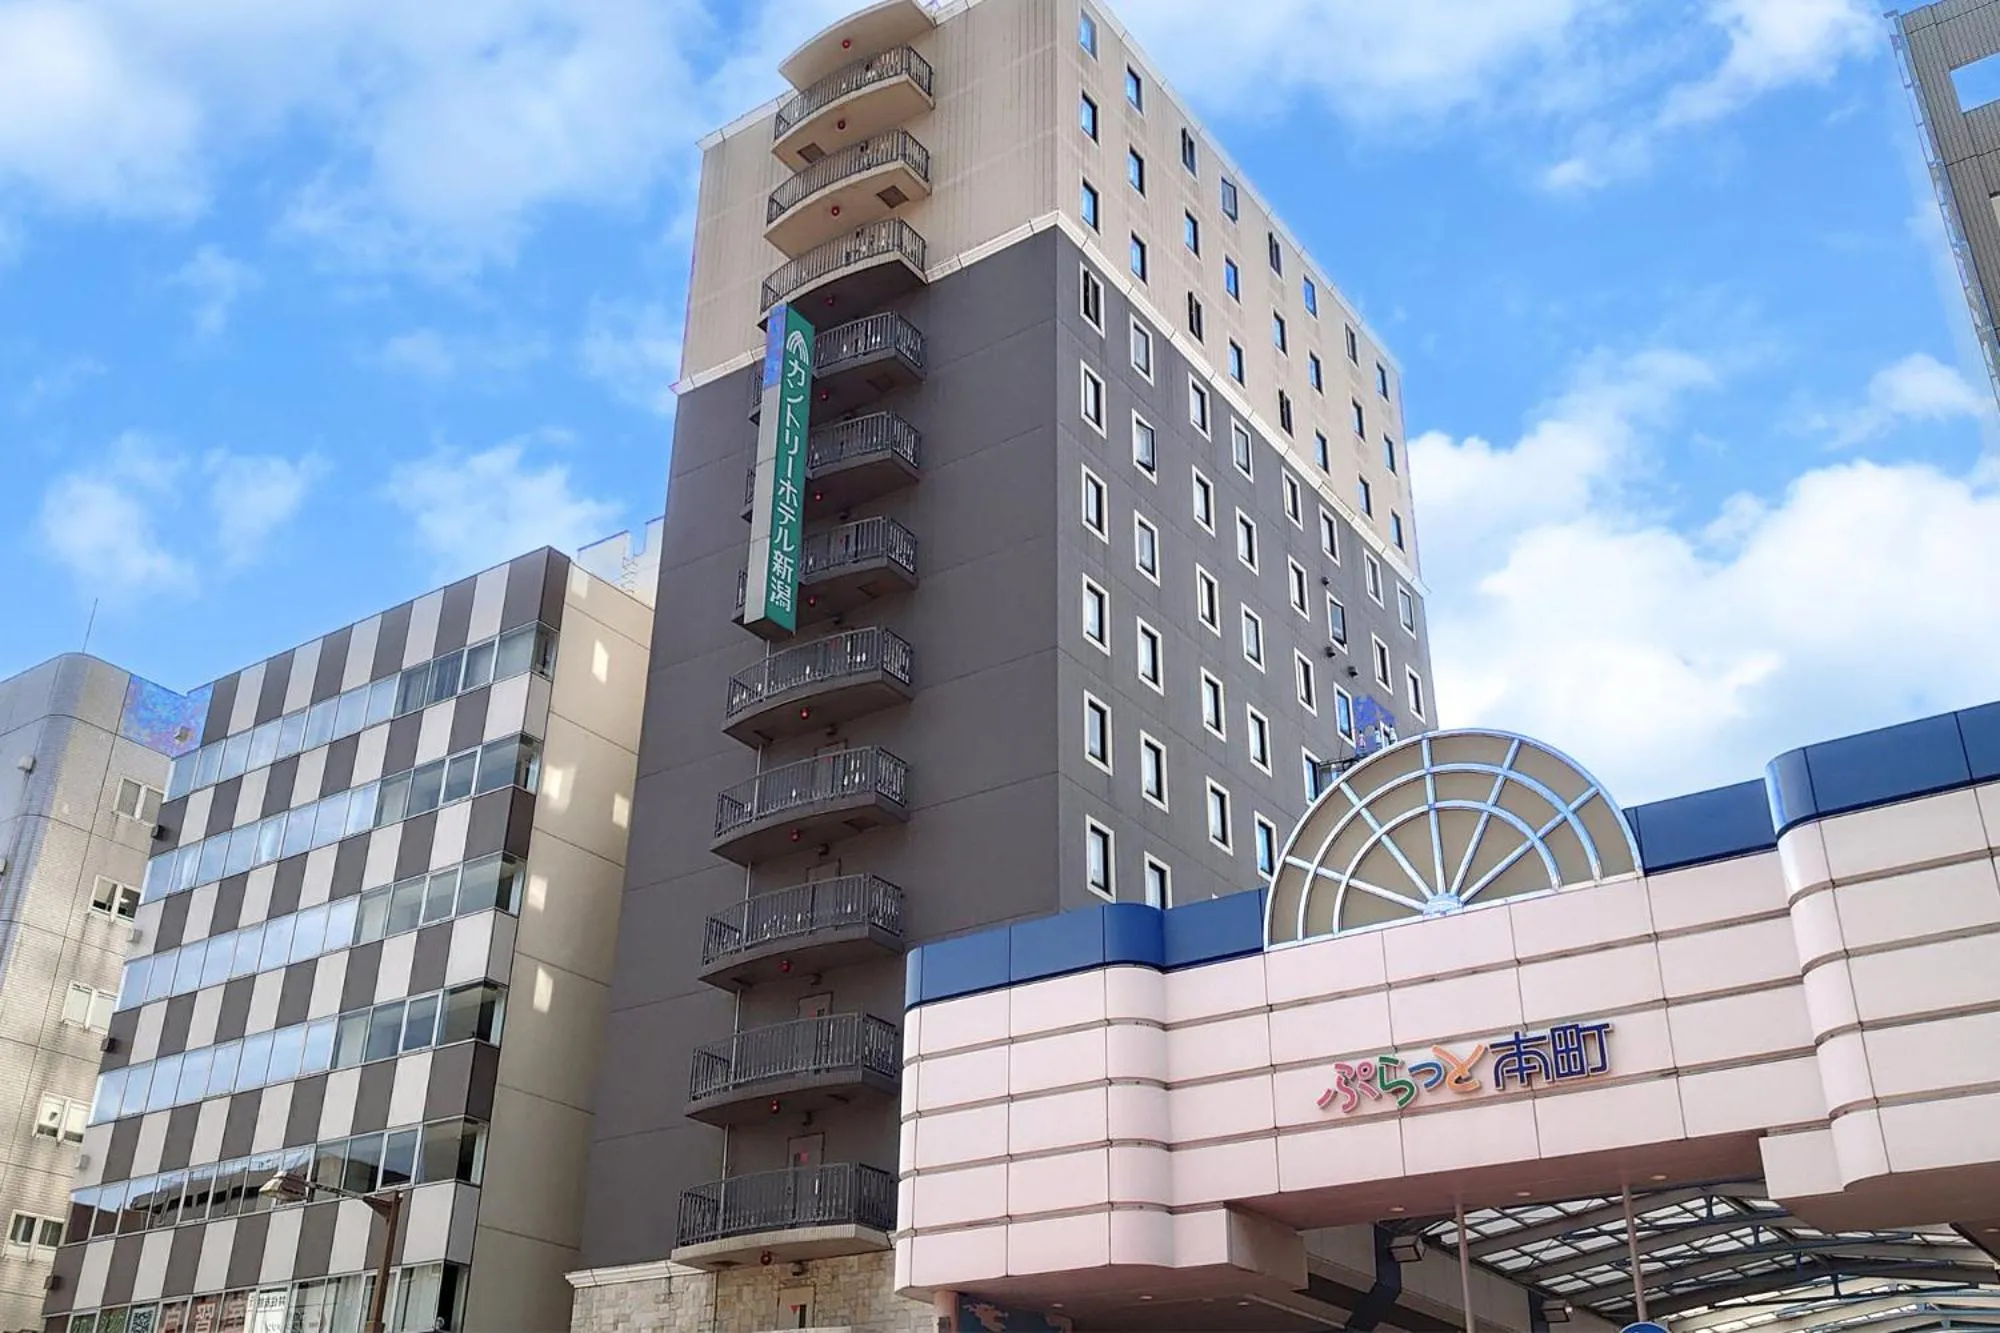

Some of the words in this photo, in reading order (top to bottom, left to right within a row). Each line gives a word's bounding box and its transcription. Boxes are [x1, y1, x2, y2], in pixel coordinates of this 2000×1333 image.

[769, 358, 806, 613] カントリーホテル新潟
[1316, 1022, 1615, 1113] ぷらっと本町
